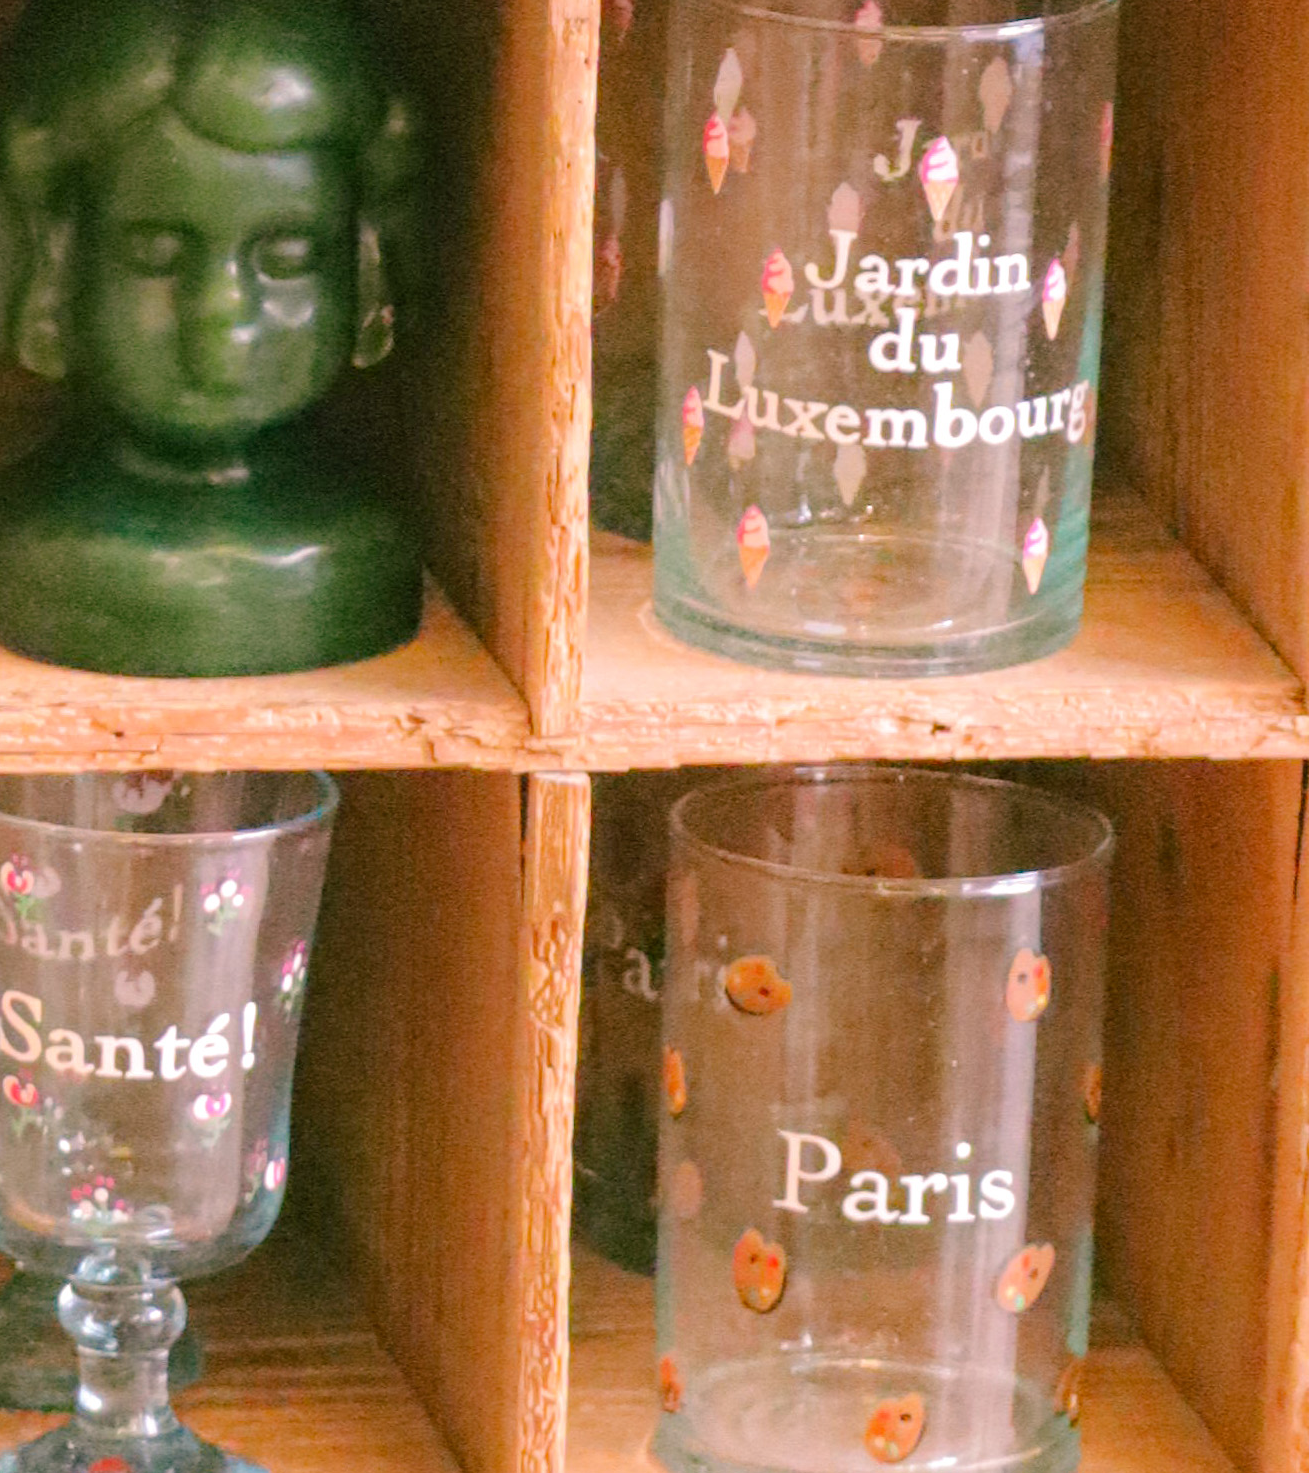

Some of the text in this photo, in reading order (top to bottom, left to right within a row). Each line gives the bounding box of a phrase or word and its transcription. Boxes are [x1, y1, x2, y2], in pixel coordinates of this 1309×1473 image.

[804, 228, 1032, 298] Jardin
[868, 306, 962, 374] du
[702, 348, 1091, 450] Luxembourg
[772, 1128, 1017, 1226] Paris
